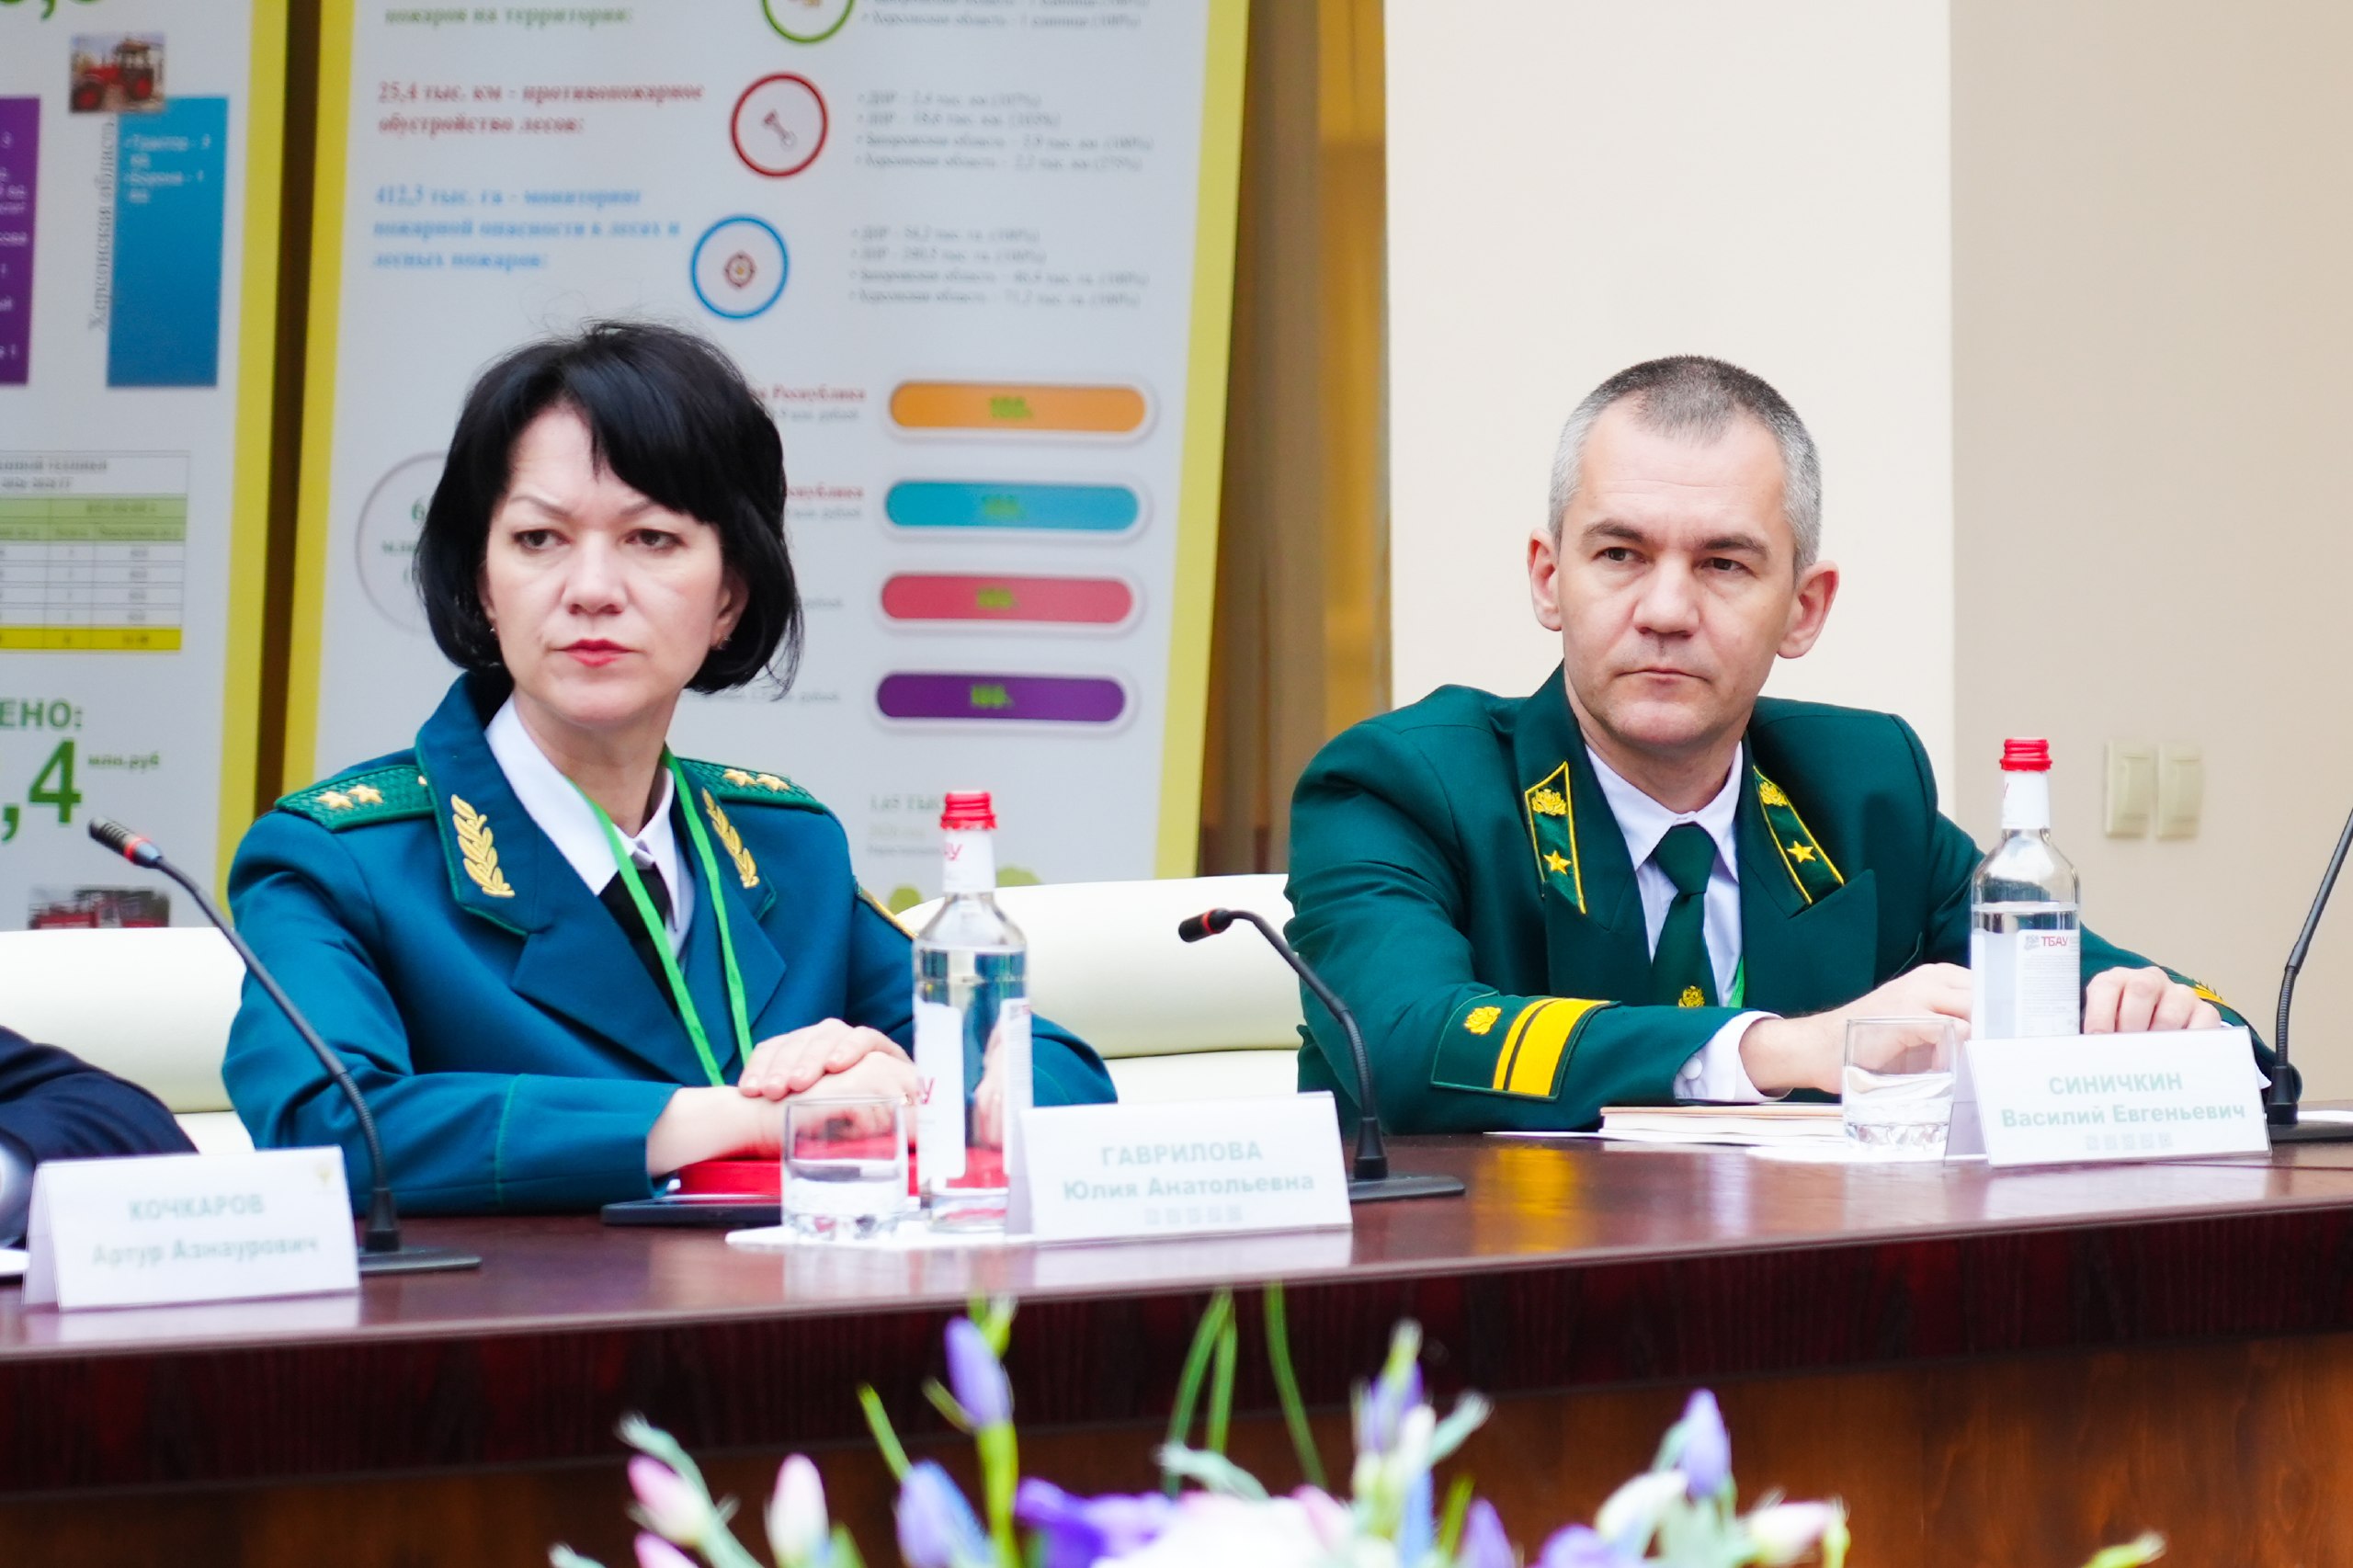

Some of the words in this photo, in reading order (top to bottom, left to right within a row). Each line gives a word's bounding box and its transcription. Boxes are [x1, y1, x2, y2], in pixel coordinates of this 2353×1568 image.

[473, 10, 497, 24] на
[378, 81, 418, 103] 25,4
[425, 85, 464, 101] тыс.
[472, 85, 502, 100] км
[522, 85, 704, 107] противопожарное
[379, 113, 514, 139] обустройство
[430, 190, 470, 205] тыс.
[2040, 936, 2068, 947] ТБАУ
[2049, 1073, 2183, 1095] СИНИЧКИН
[2001, 1106, 2105, 1128] Василий
[2112, 1103, 2245, 1123] Евгеньевич
[1101, 1141, 1263, 1166] ГАВРИЛОВА
[1063, 1180, 1138, 1200] Юлия
[1147, 1175, 1314, 1197] Анатольевна
[129, 1194, 265, 1221] КОЧКАРОВ
[93, 1244, 164, 1269] Артур
[173, 1237, 319, 1263] Азнаурович
